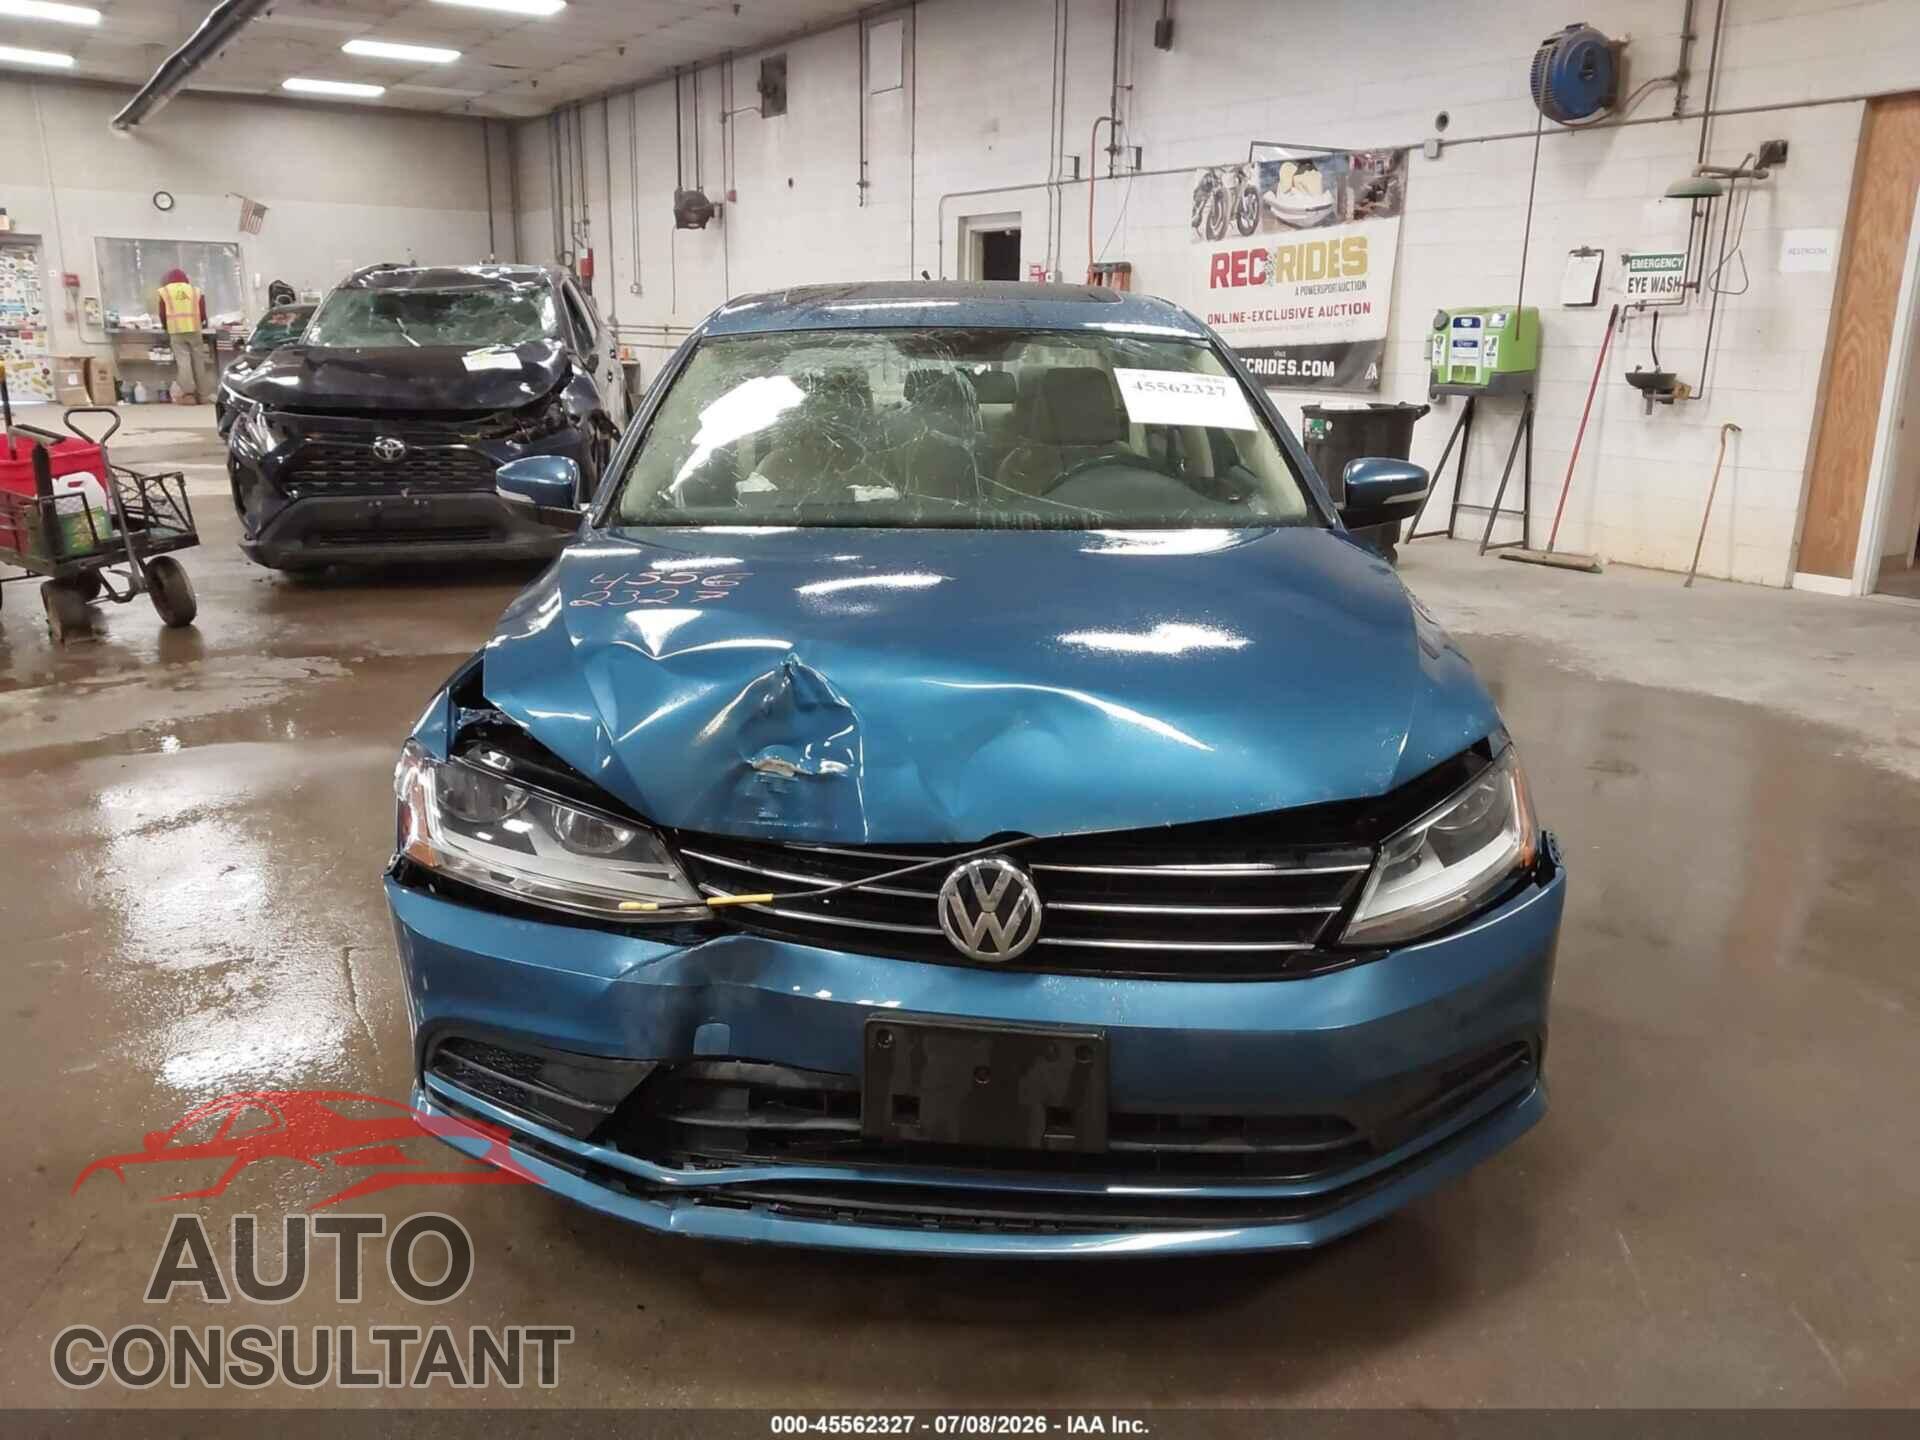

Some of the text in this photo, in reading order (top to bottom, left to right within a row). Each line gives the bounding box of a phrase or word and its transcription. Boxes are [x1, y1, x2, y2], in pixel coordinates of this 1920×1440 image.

[1209, 236, 1368, 289] REC RIDES
[1631, 256, 1684, 269] EMERGENCY
[1627, 275, 1681, 293] EYE WASH
[1207, 302, 1371, 325] ONLINE-EXCLUSIVE AUCTION
[1240, 358, 1335, 377] CRIDES.COM
[1131, 380, 1226, 397] 45562327
[590, 572, 754, 590] 4556
[941, 862, 1038, 959] VW
